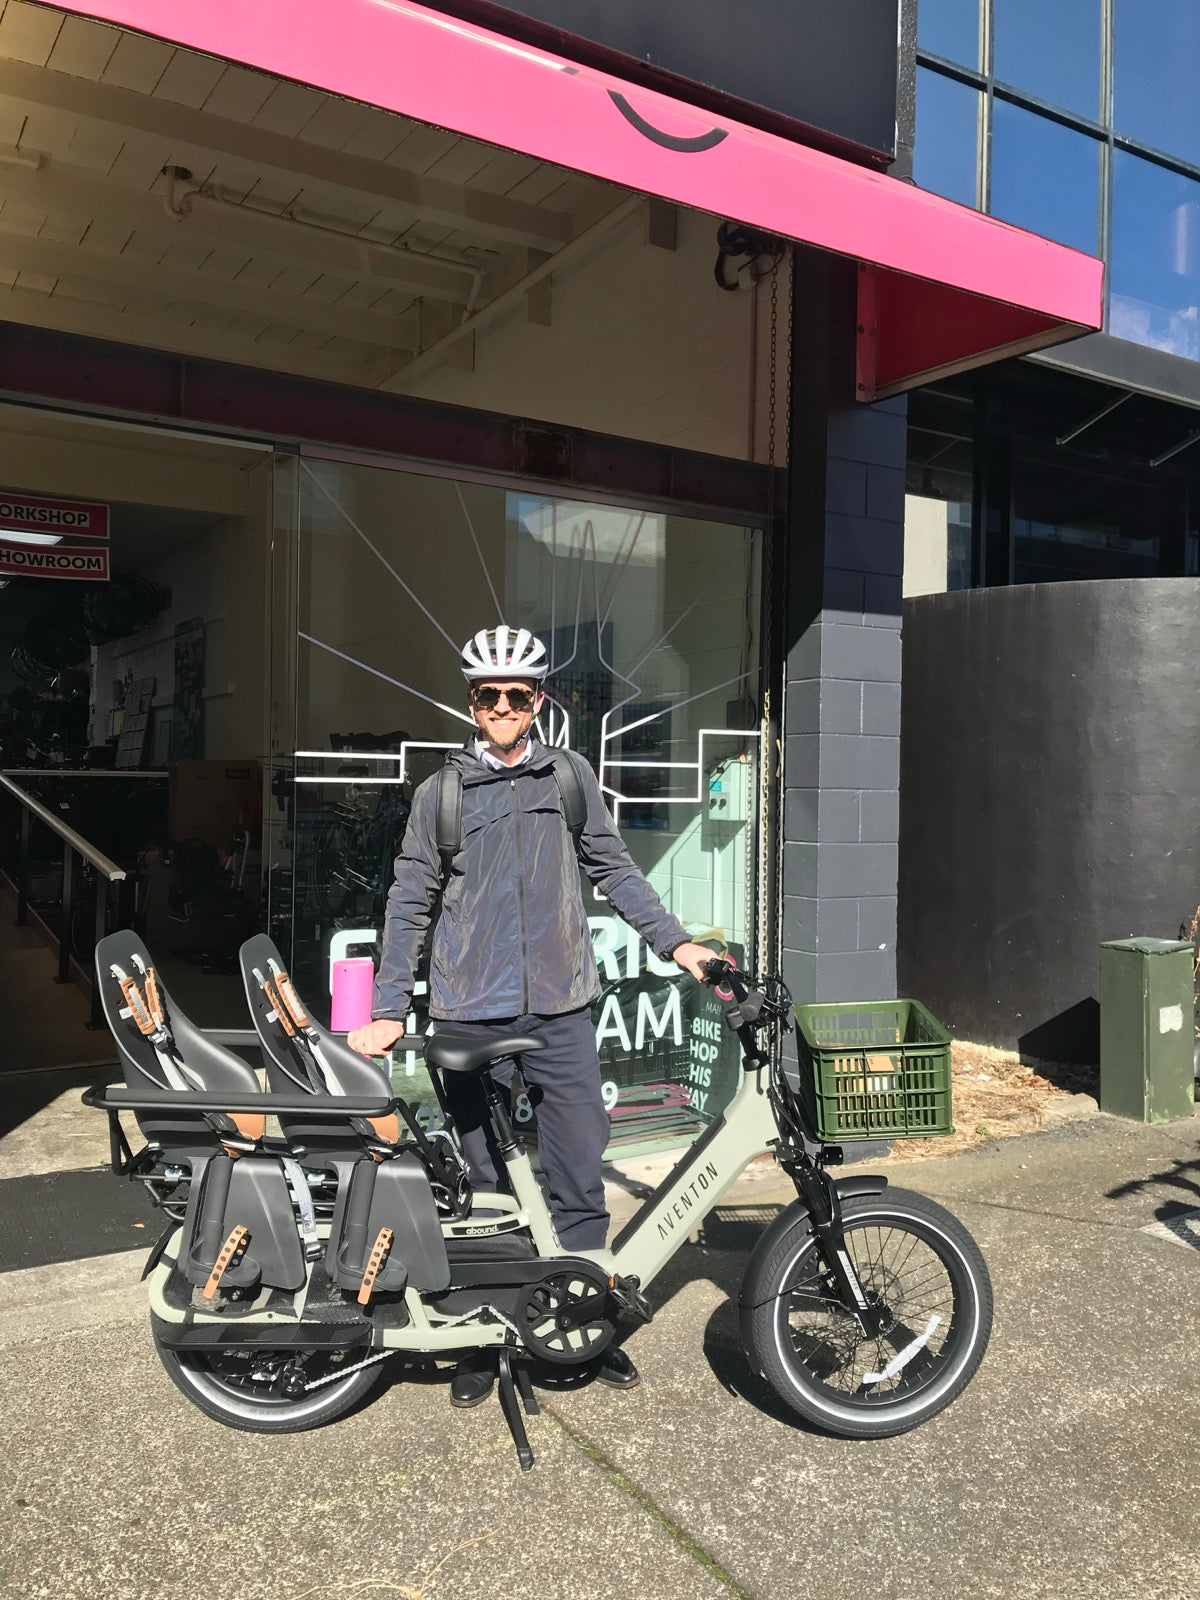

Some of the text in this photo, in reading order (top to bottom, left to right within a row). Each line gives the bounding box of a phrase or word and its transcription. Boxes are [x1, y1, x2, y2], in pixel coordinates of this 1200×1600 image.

[0, 504, 88, 526] ORKSHOP
[0, 549, 102, 570] HOWROOM
[596, 988, 684, 1052] AM
[689, 1038, 719, 1063] HOP
[689, 1063, 712, 1087] HIS
[601, 1081, 619, 1111] 9
[656, 1161, 719, 1241] AVENTON
